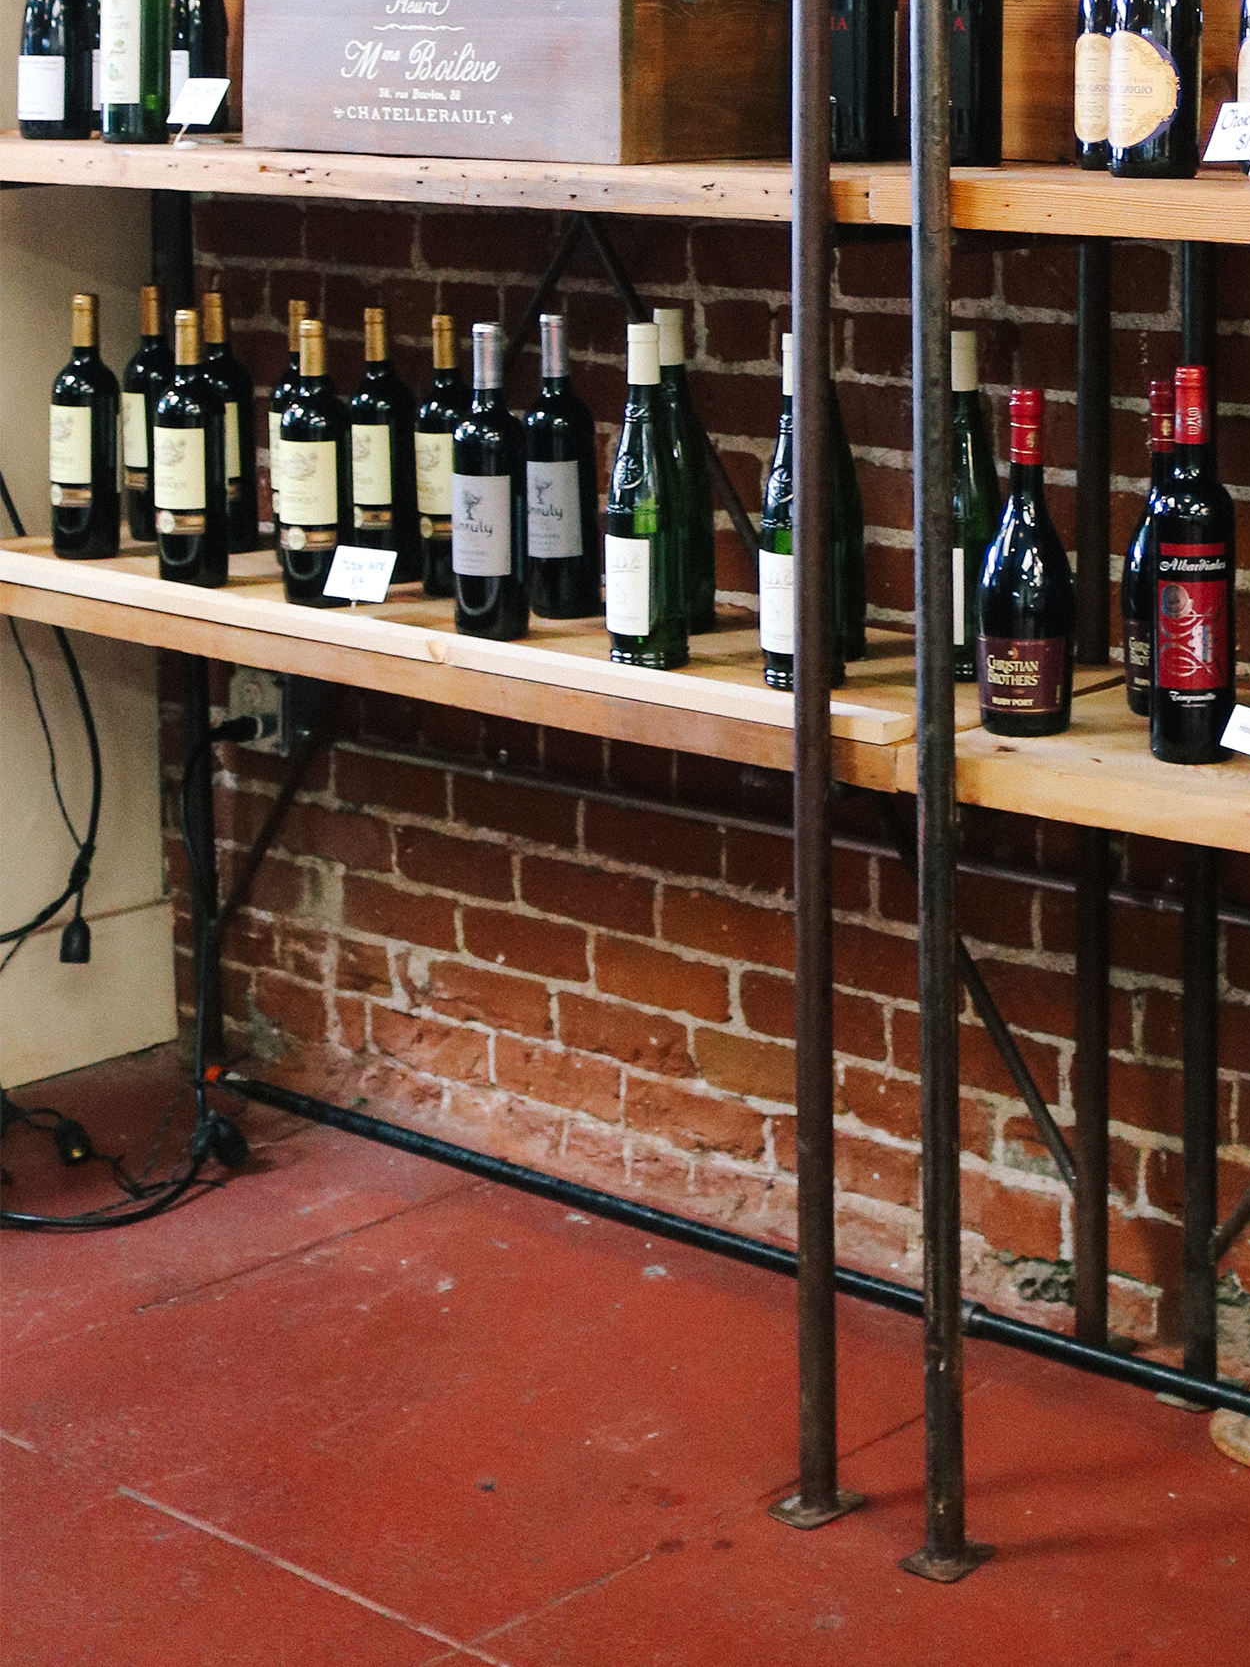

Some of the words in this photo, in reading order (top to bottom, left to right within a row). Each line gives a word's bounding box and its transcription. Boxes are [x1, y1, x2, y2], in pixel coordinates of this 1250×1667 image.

[405, 39, 502, 83] Boilève
[346, 105, 498, 125] CHATELLERAULT
[986, 654, 1039, 674] CHRISTIAN
